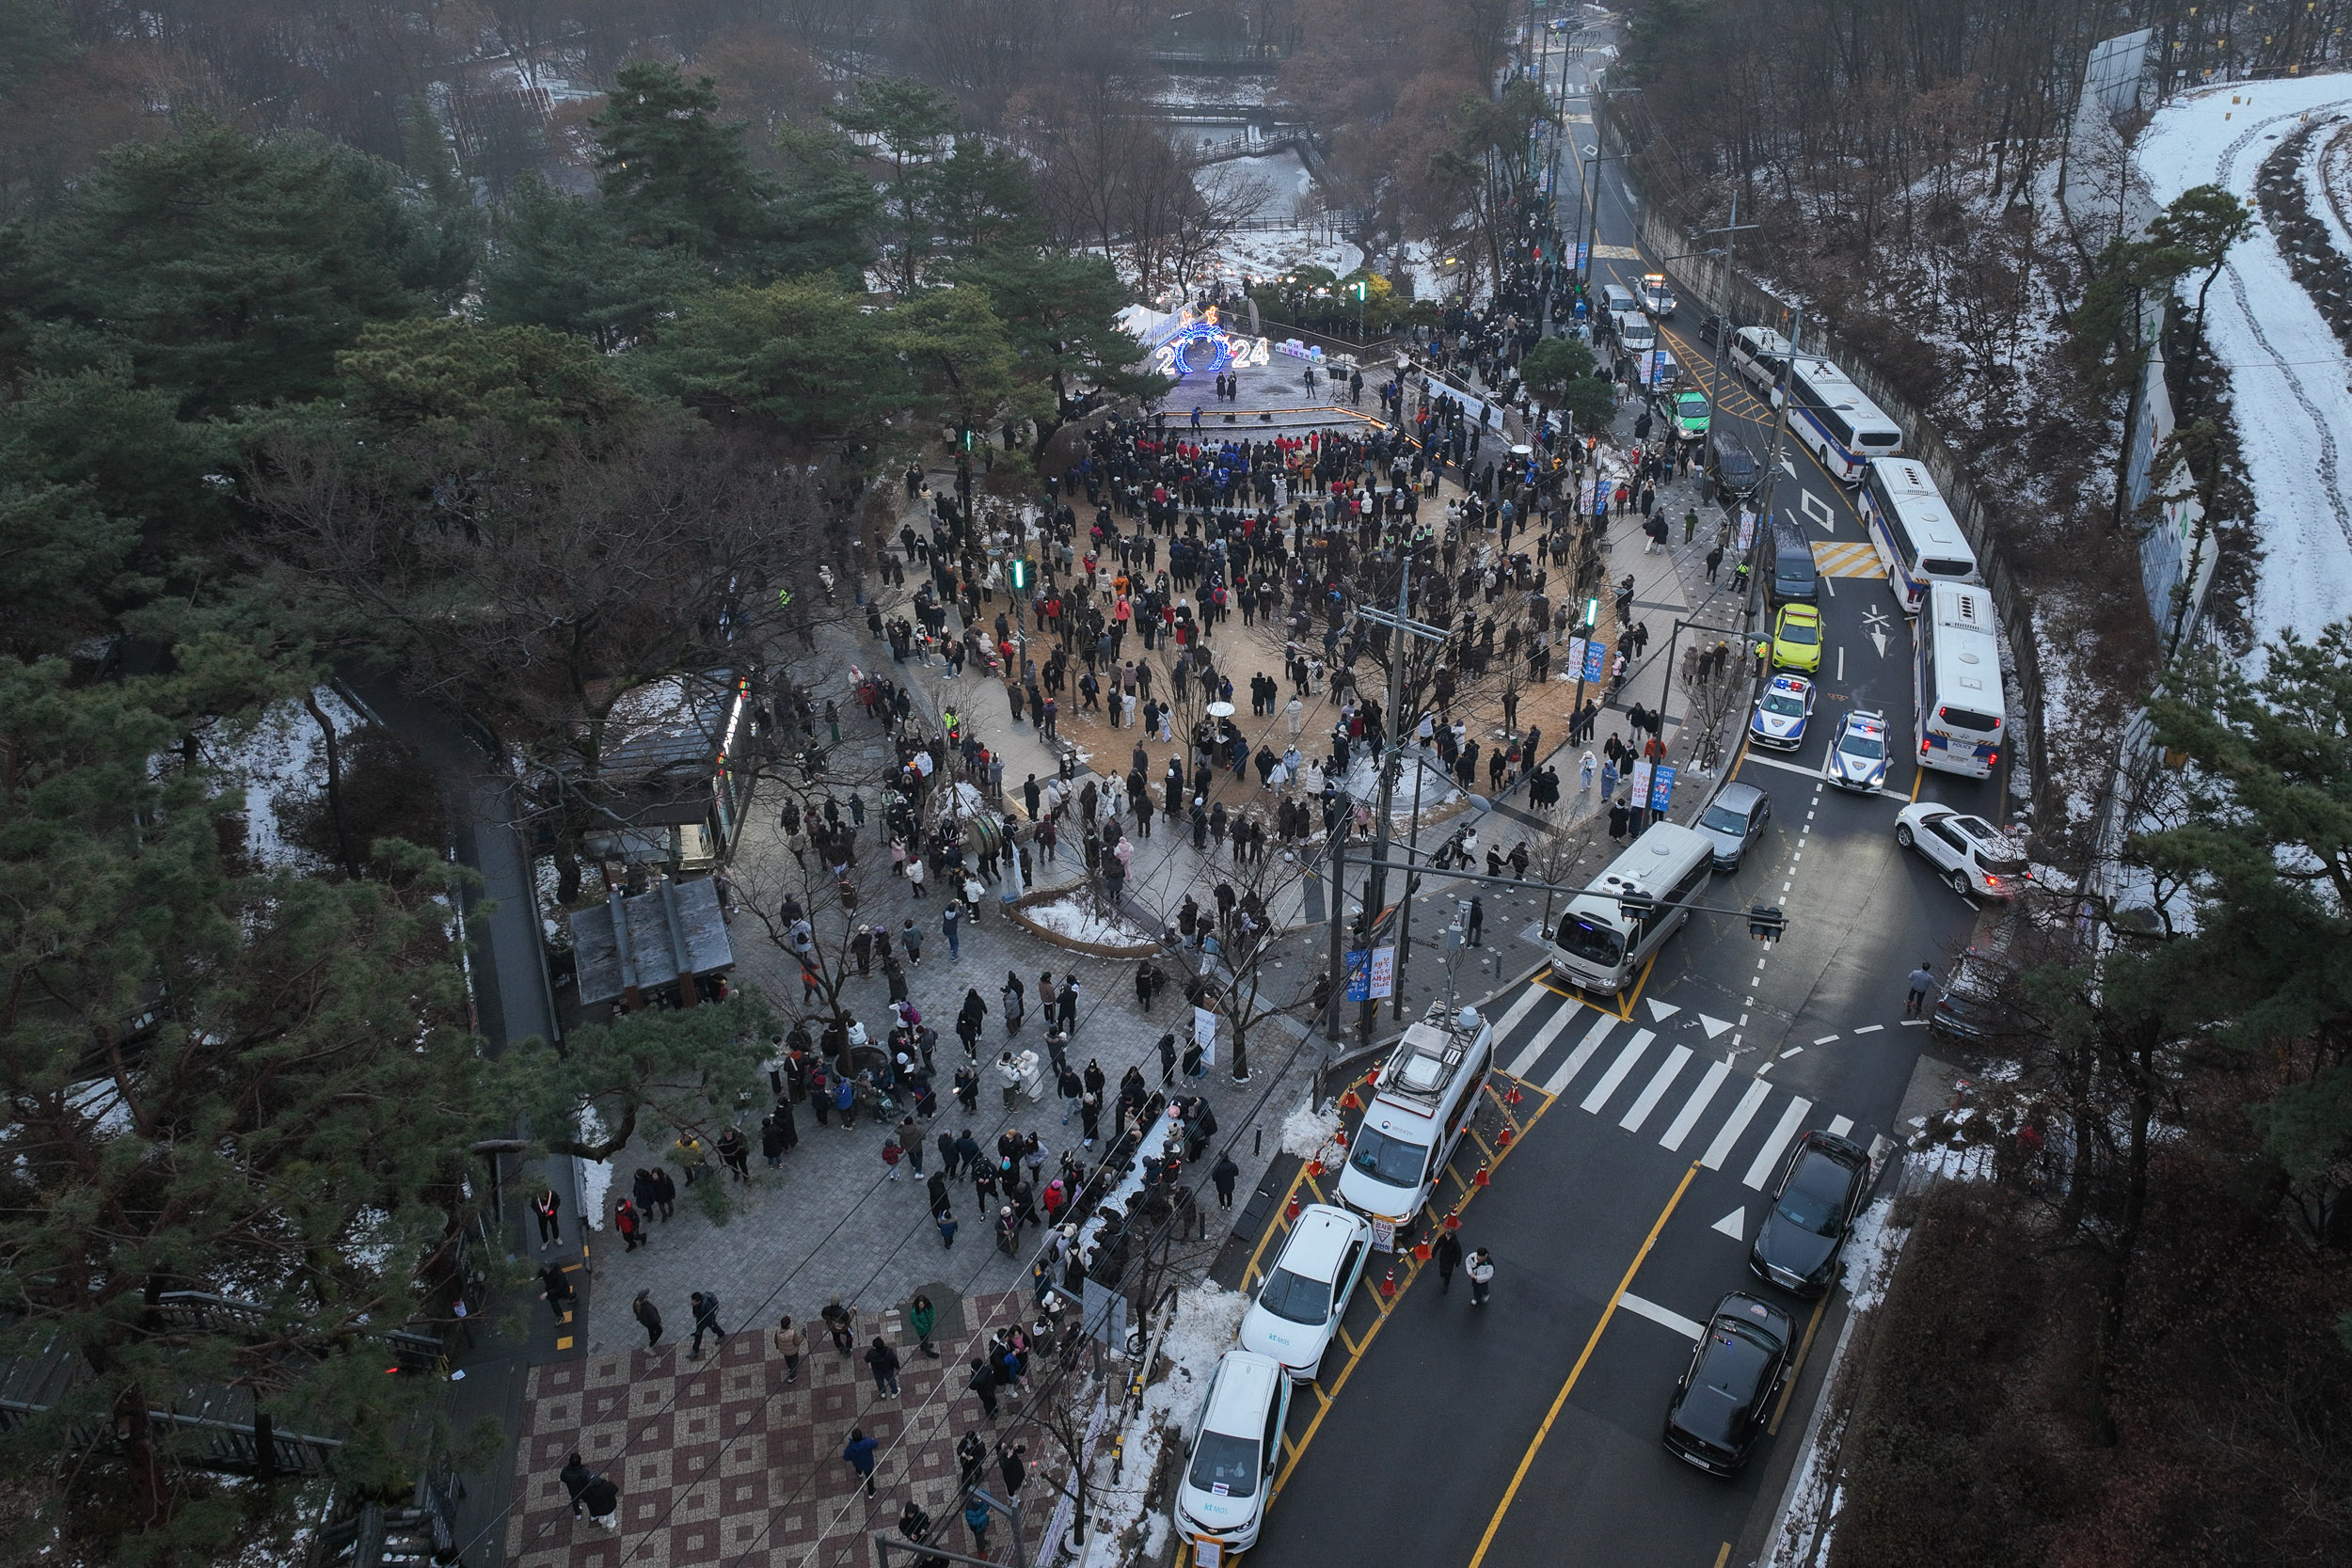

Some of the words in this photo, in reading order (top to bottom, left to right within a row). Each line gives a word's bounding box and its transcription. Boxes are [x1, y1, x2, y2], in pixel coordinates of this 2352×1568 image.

[1372, 974, 1391, 983] 새해
[1375, 1221, 1392, 1231] 공사중
[1268, 1333, 1277, 1341] kt
[1277, 1337, 1290, 1346] MOS
[1204, 1502, 1213, 1512] kt
[1214, 1506, 1228, 1514] MOS
